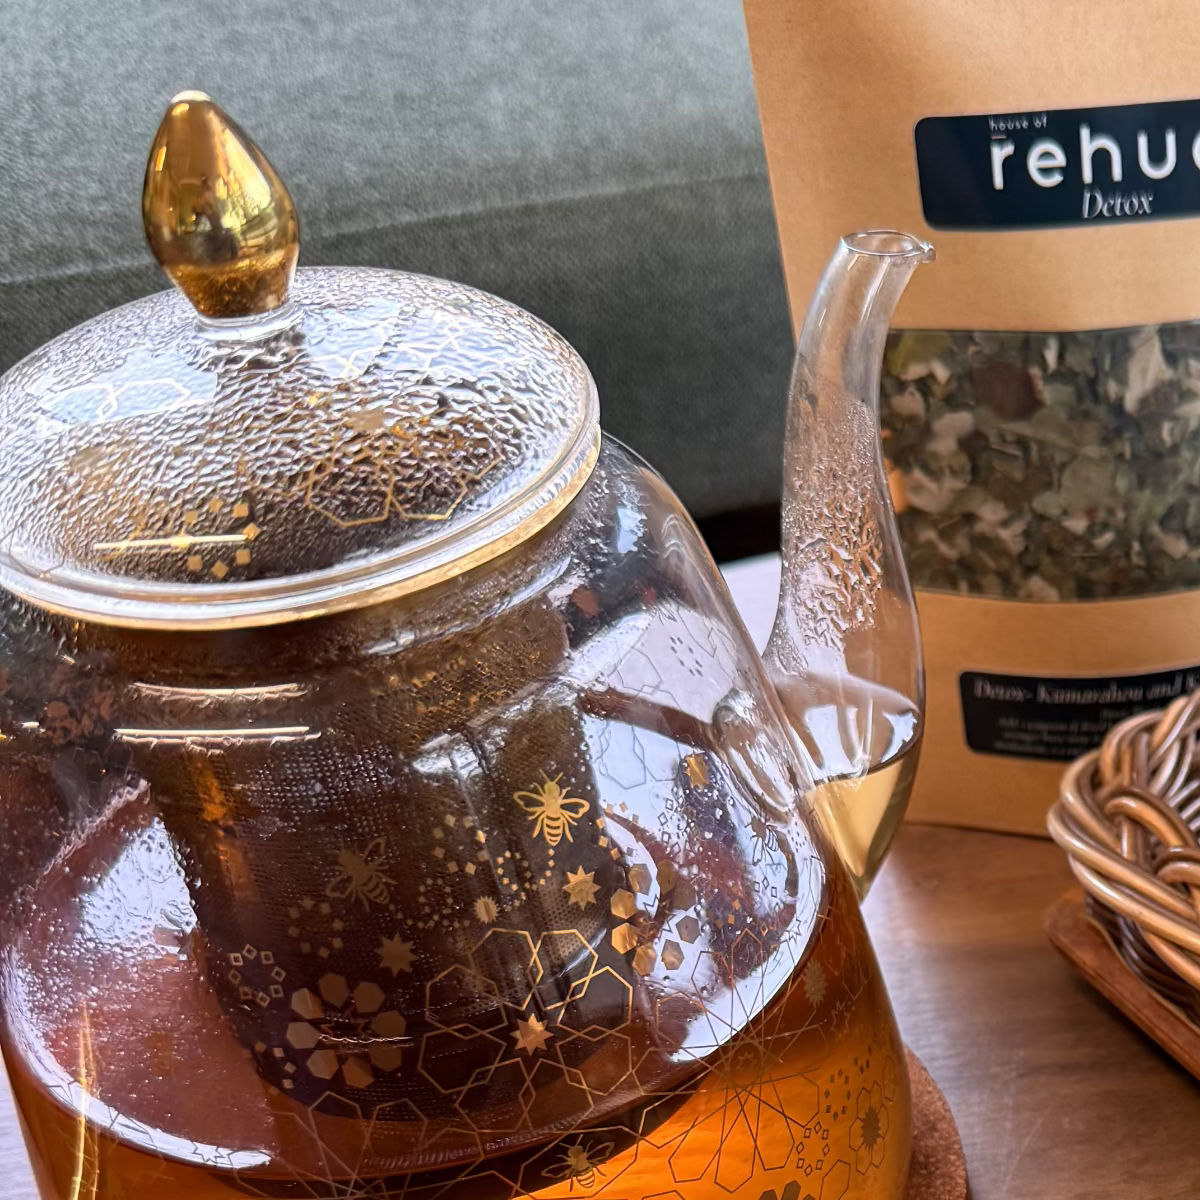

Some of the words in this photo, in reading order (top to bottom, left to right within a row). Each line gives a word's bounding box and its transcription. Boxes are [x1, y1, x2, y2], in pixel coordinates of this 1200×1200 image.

[988, 115, 1029, 132] house
[1033, 111, 1048, 129] of
[1082, 187, 1154, 220] Detox
